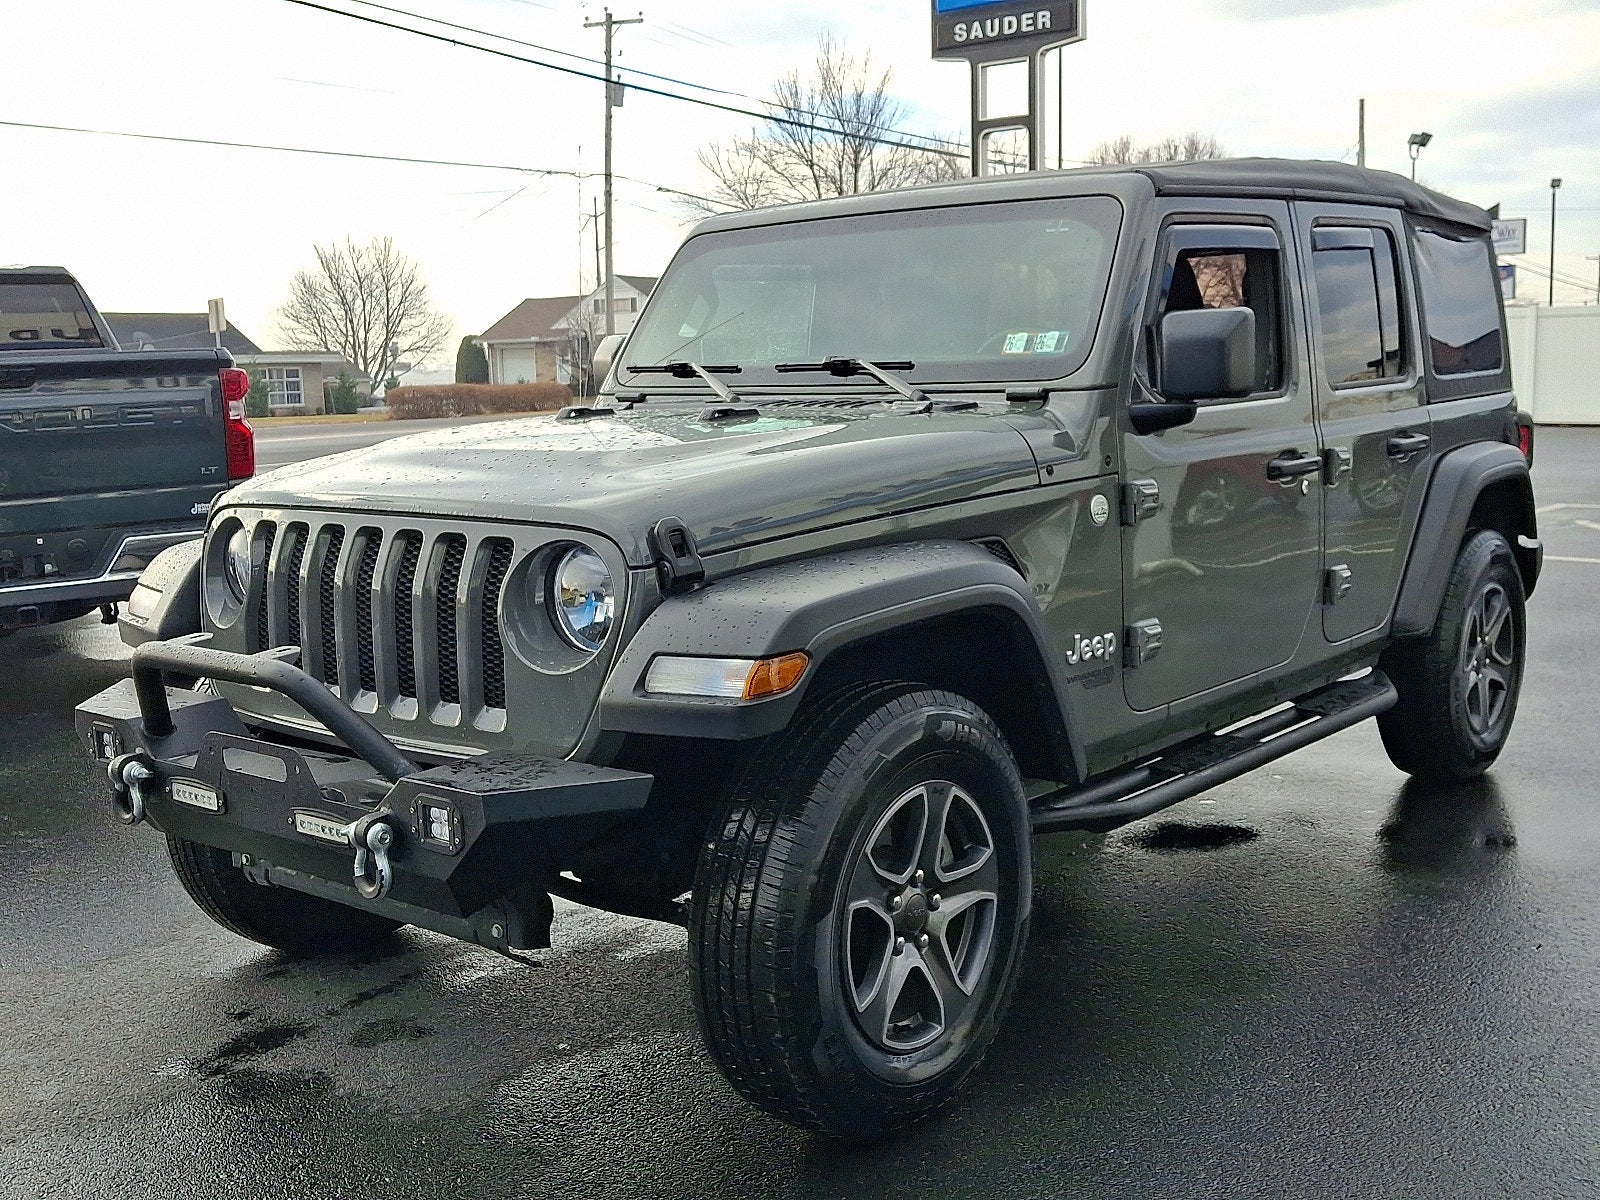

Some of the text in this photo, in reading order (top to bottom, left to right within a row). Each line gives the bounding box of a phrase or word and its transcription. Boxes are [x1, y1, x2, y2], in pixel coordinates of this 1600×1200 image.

[953, 10, 1051, 42] SAUDER
[201, 466, 218, 474] LT
[1066, 632, 1117, 665] Jeep
